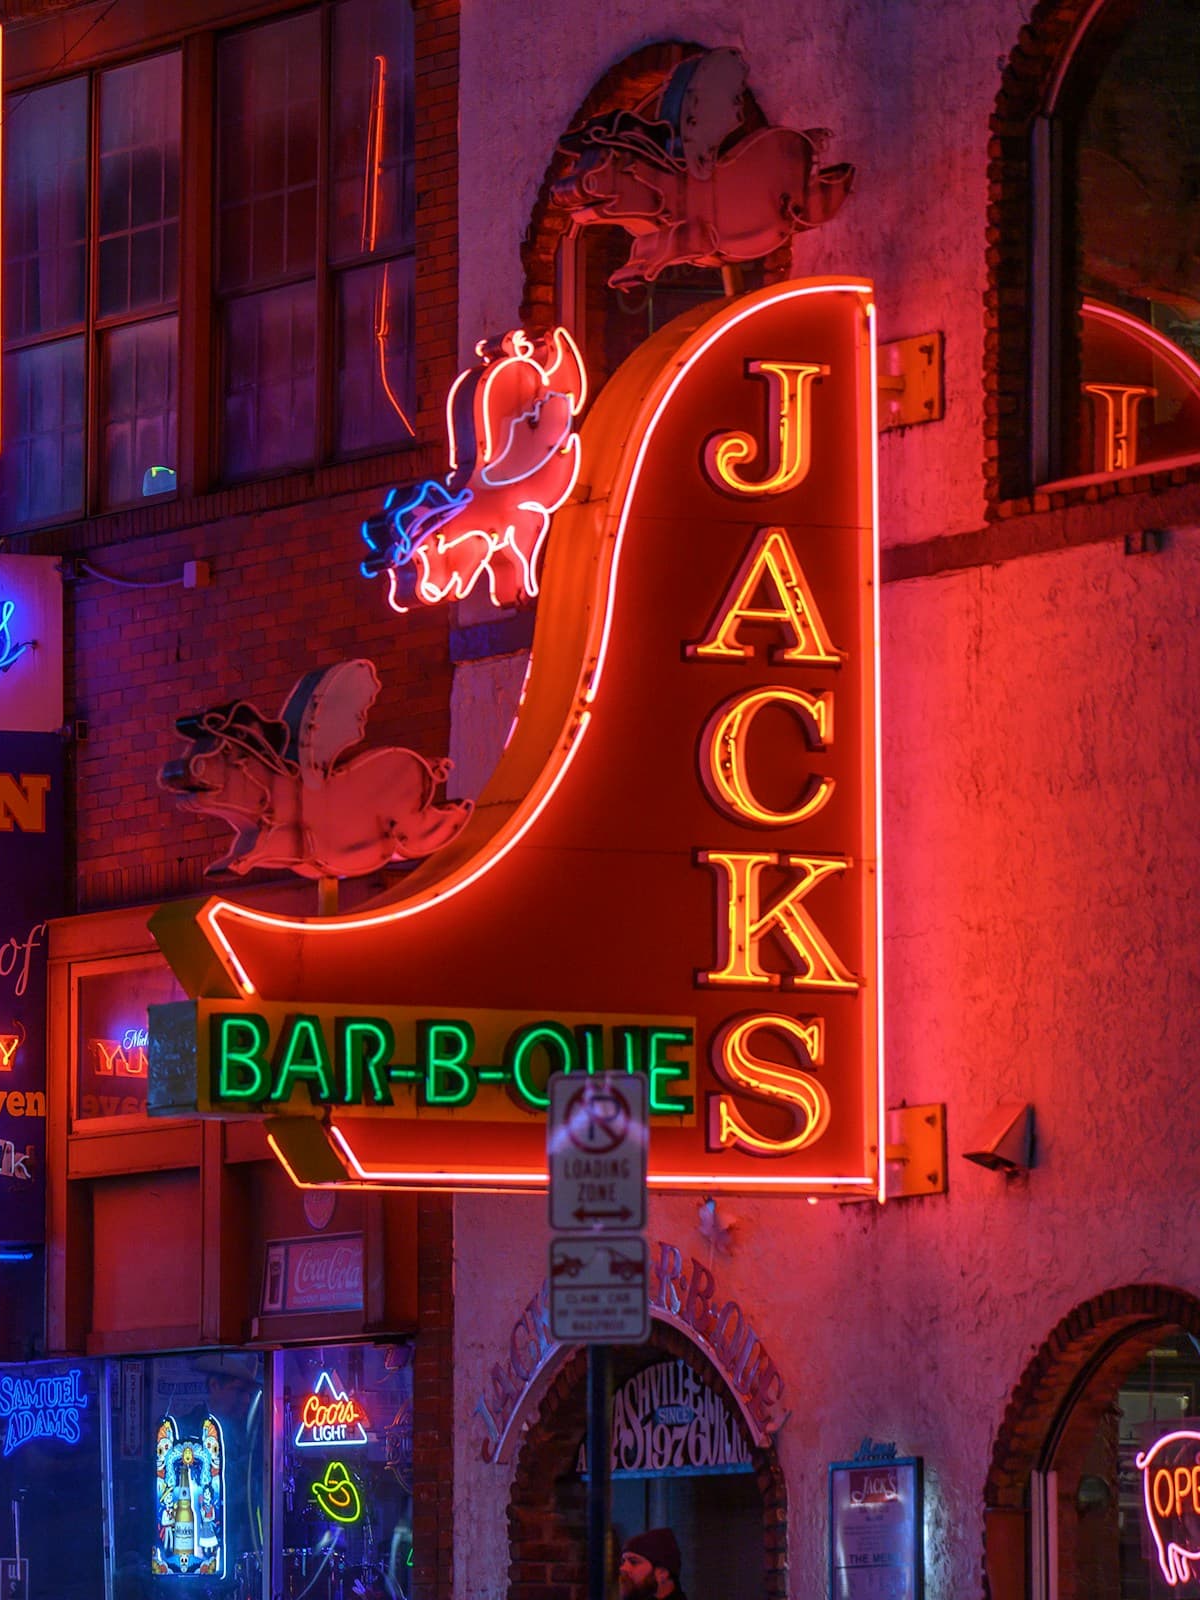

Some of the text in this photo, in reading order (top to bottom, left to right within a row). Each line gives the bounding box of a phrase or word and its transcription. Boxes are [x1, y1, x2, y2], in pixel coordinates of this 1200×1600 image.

[681, 358, 868, 1158] JACKS
[563, 1159, 631, 1180] LOADING
[576, 1183, 618, 1202] ZONE
[294, 1246, 362, 1293] Coca-Cola
[303, 1395, 360, 1428] Coors
[657, 1407, 690, 1425] SINCE
[3, 1408, 81, 1457] ADAMS
[313, 1424, 348, 1441] LIGHT
[641, 1419, 706, 1469] 1976
[852, 1471, 898, 1504] JACK'S
[849, 1553, 868, 1565] THE
